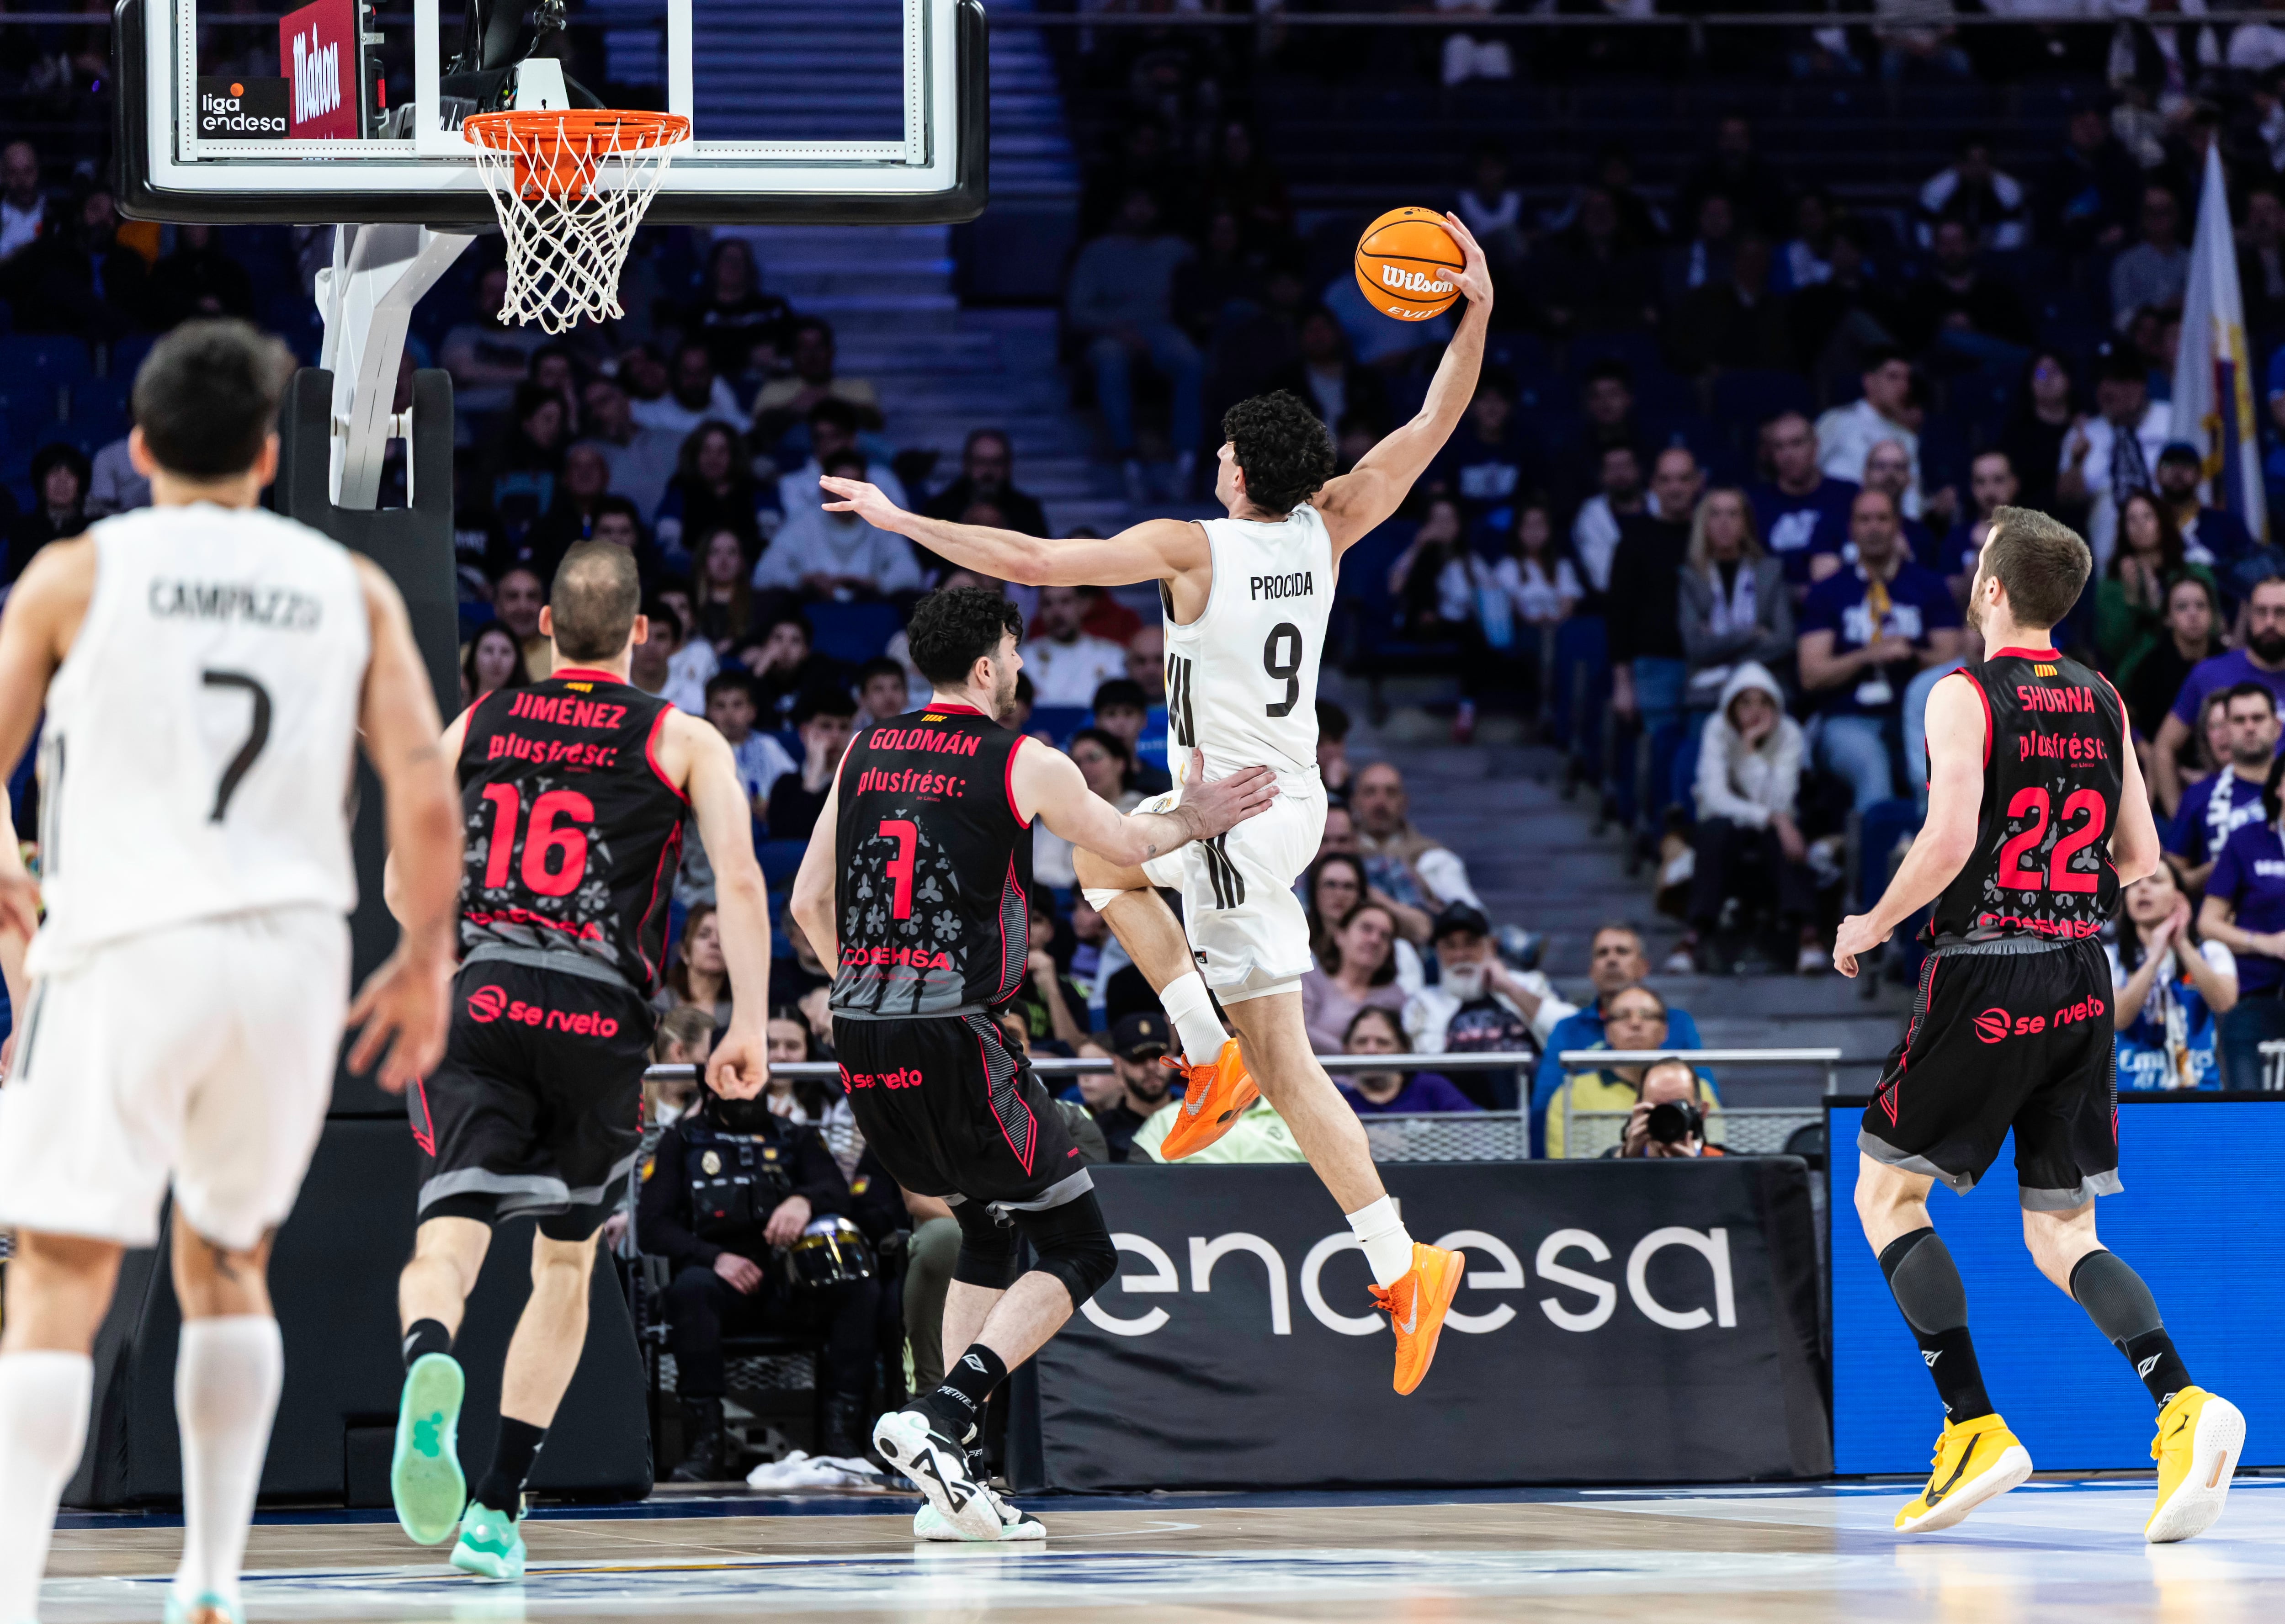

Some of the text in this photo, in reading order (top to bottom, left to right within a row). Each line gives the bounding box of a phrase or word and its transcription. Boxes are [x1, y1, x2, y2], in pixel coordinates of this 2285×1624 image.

[292, 21, 340, 125] Mahou
[203, 93, 240, 114] liga
[203, 113, 285, 131] endesa
[1382, 264, 1453, 293] Wilson
[1250, 571, 1313, 600] PROCIDA
[1263, 622, 1303, 717] 9
[509, 691, 627, 729] JIMÉNEZ
[2016, 685, 2095, 714] SHURNA
[202, 668, 273, 825] 7
[868, 727, 982, 757] GOLOMÁN
[482, 782, 595, 897] 16
[1997, 786, 2106, 893] 22
[841, 947, 951, 971] COSEHISA
